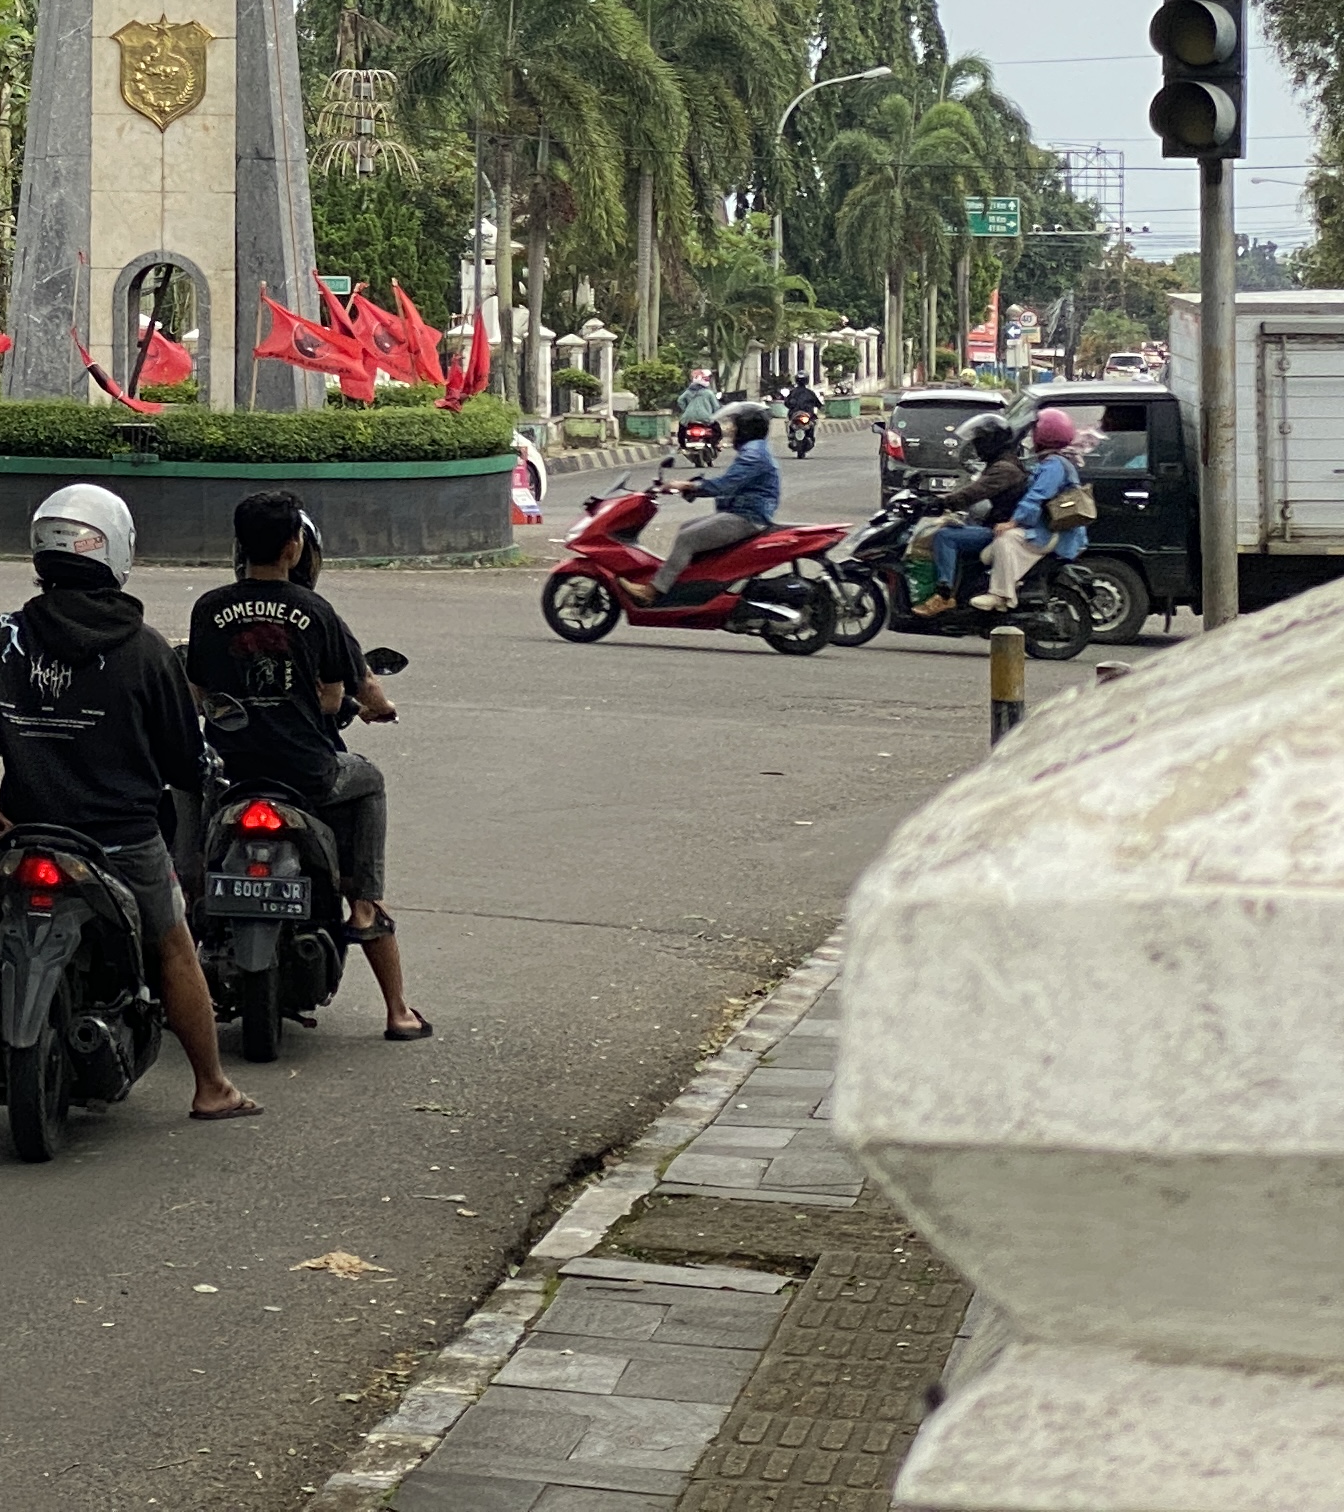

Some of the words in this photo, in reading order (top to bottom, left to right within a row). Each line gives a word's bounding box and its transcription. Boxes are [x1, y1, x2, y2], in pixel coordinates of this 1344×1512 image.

[214, 601, 311, 630] SOMEONE.CO
[214, 880, 224, 896] A
[282, 882, 301, 899] JR
